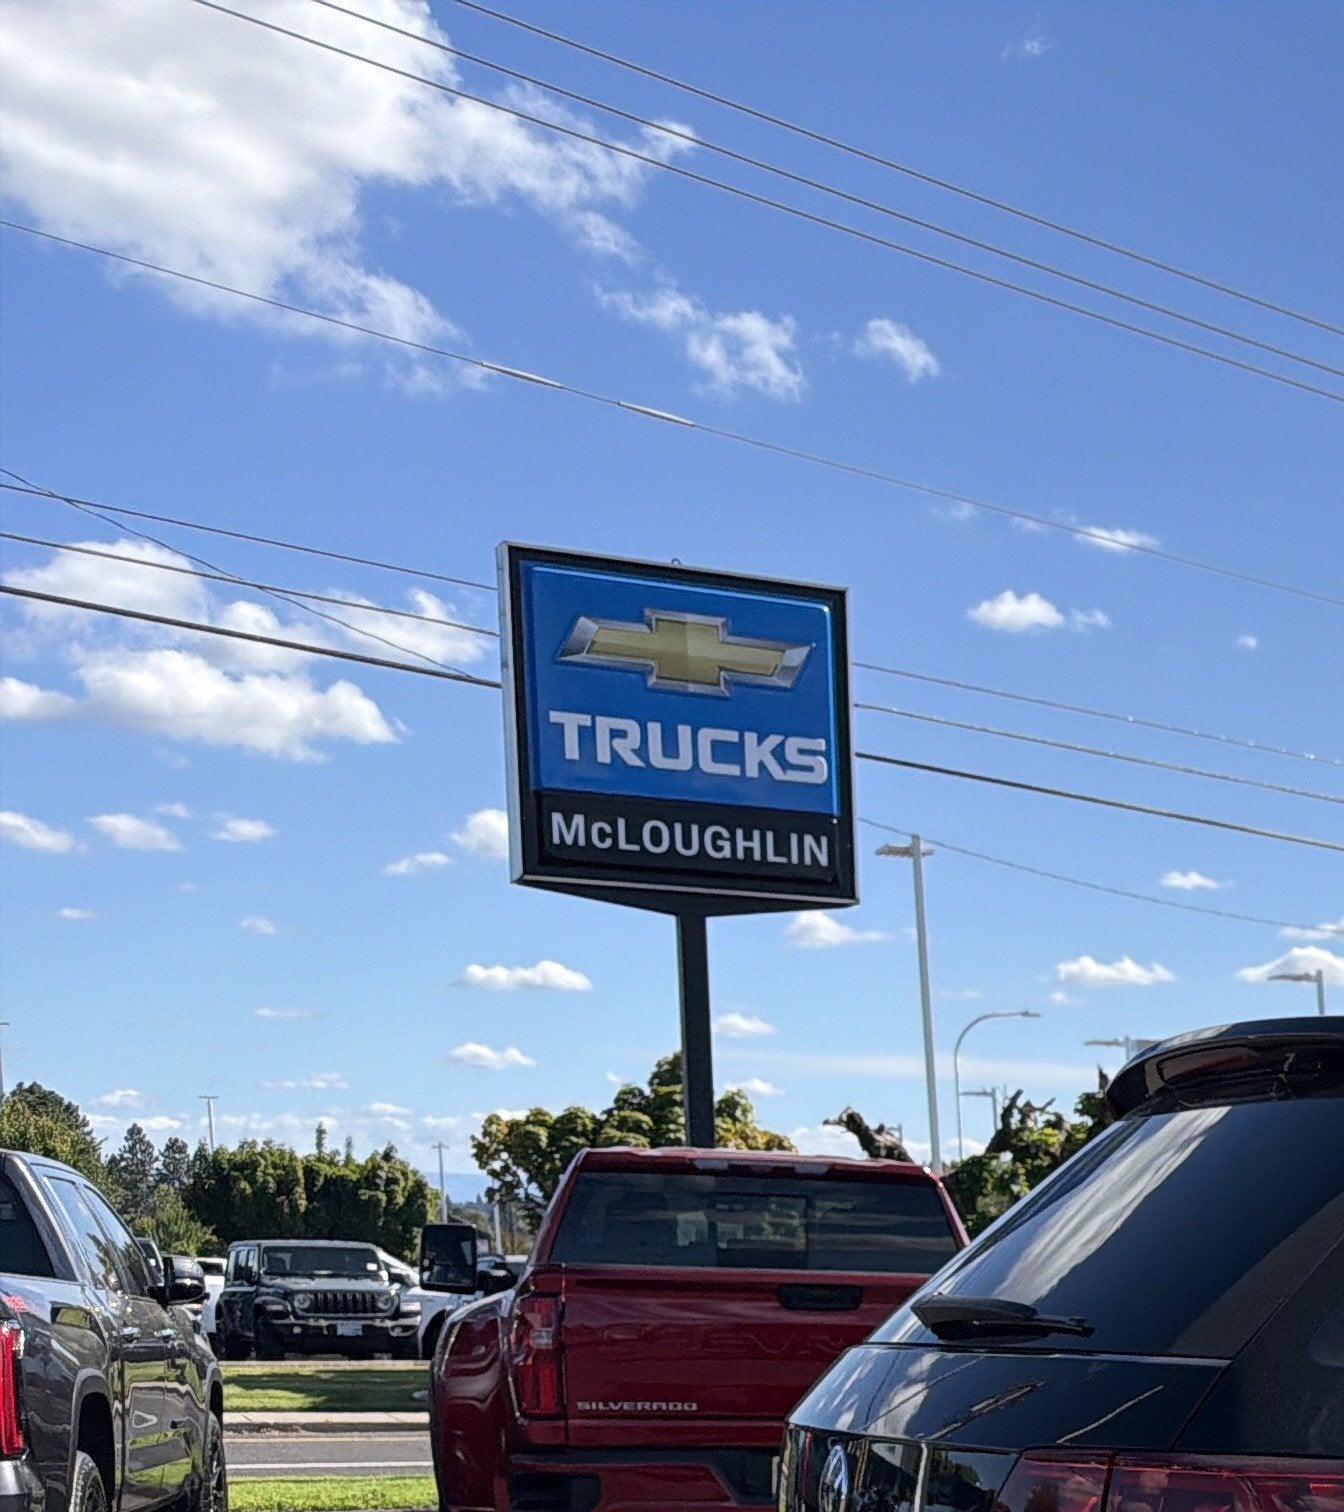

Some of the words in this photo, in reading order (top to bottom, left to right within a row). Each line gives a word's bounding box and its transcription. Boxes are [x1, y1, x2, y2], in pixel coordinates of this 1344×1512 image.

[549, 710, 828, 784] TRUCKS
[551, 811, 829, 867] McLOUGHLIN
[576, 1400, 699, 1412] SILVERADO
